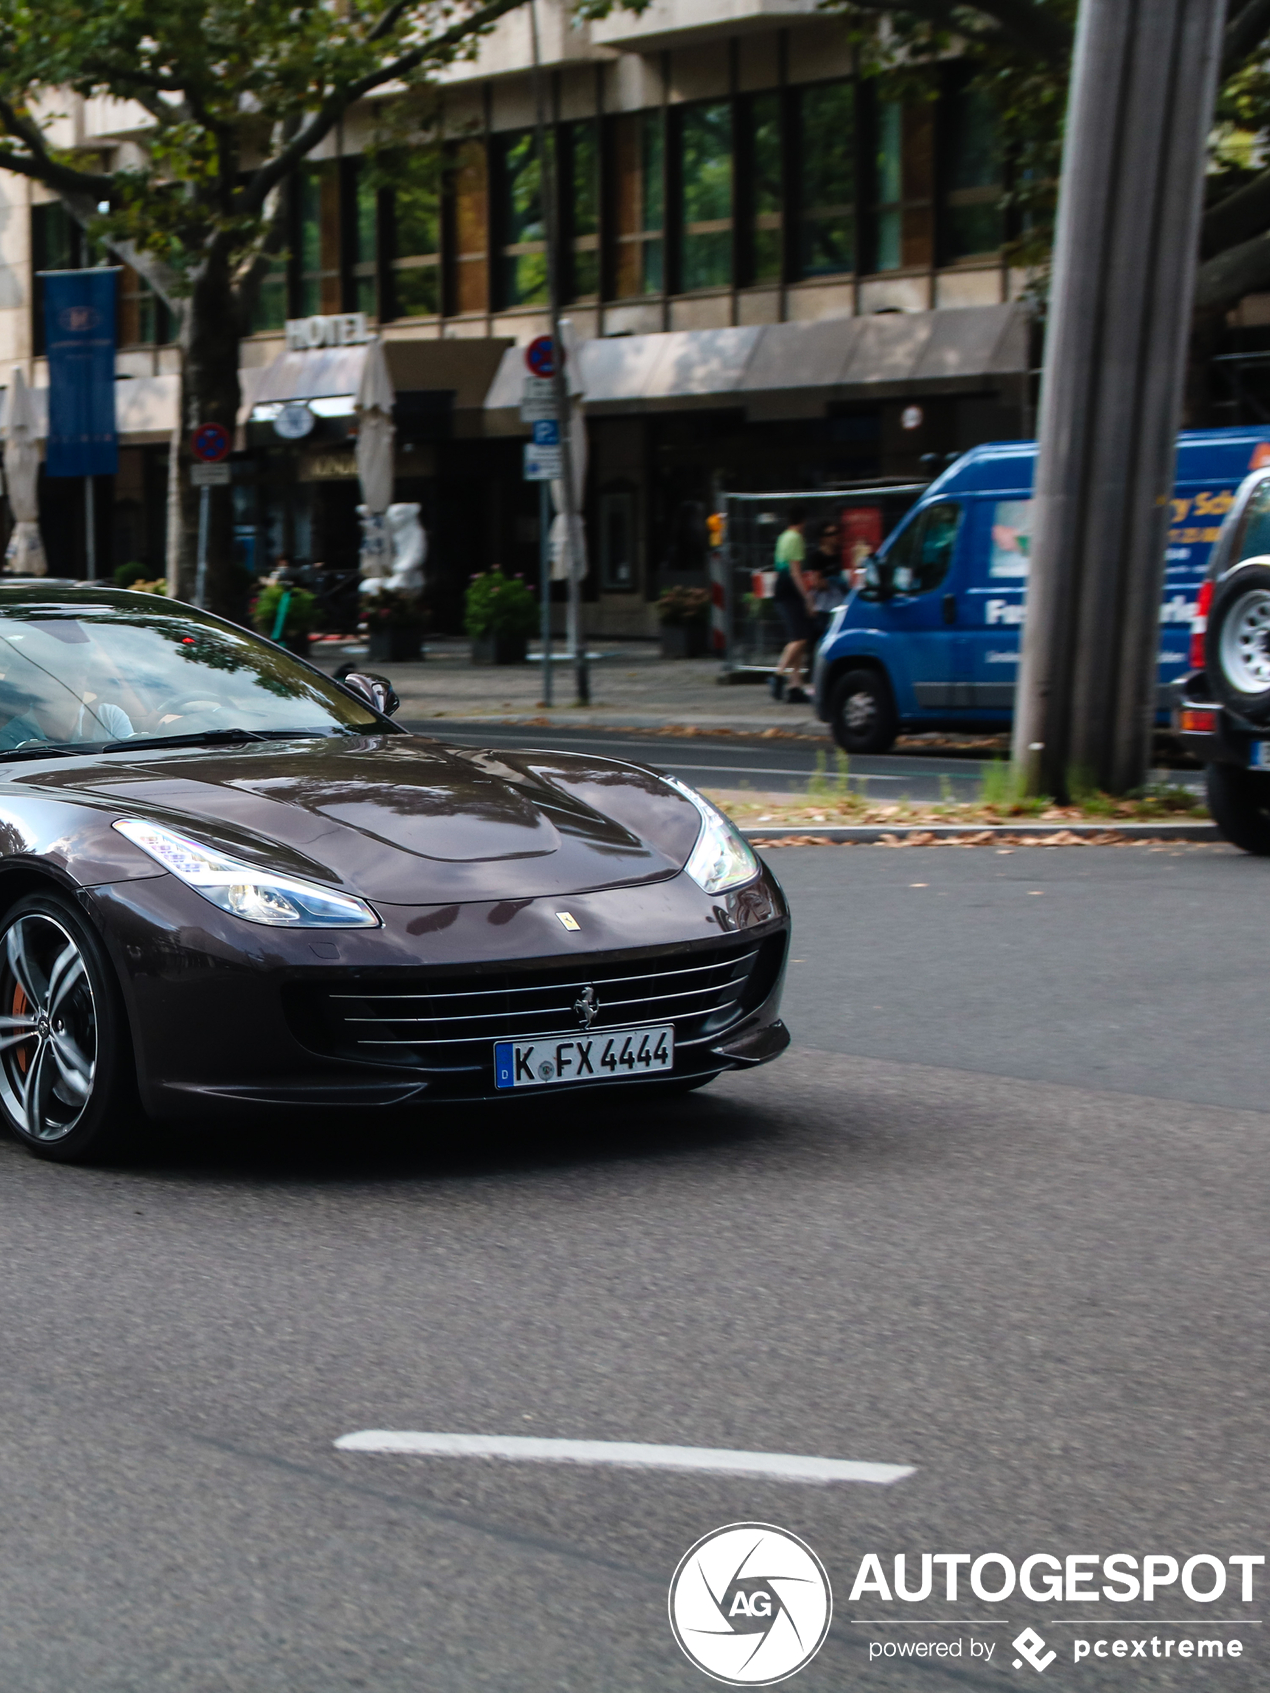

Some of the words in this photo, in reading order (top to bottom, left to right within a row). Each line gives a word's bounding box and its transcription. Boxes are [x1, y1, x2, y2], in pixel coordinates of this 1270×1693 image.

[285, 312, 378, 350] HOTEL
[501, 1069, 509, 1080] D
[515, 1045, 535, 1081] K
[556, 1040, 594, 1078] FX
[600, 1031, 669, 1072] 4444
